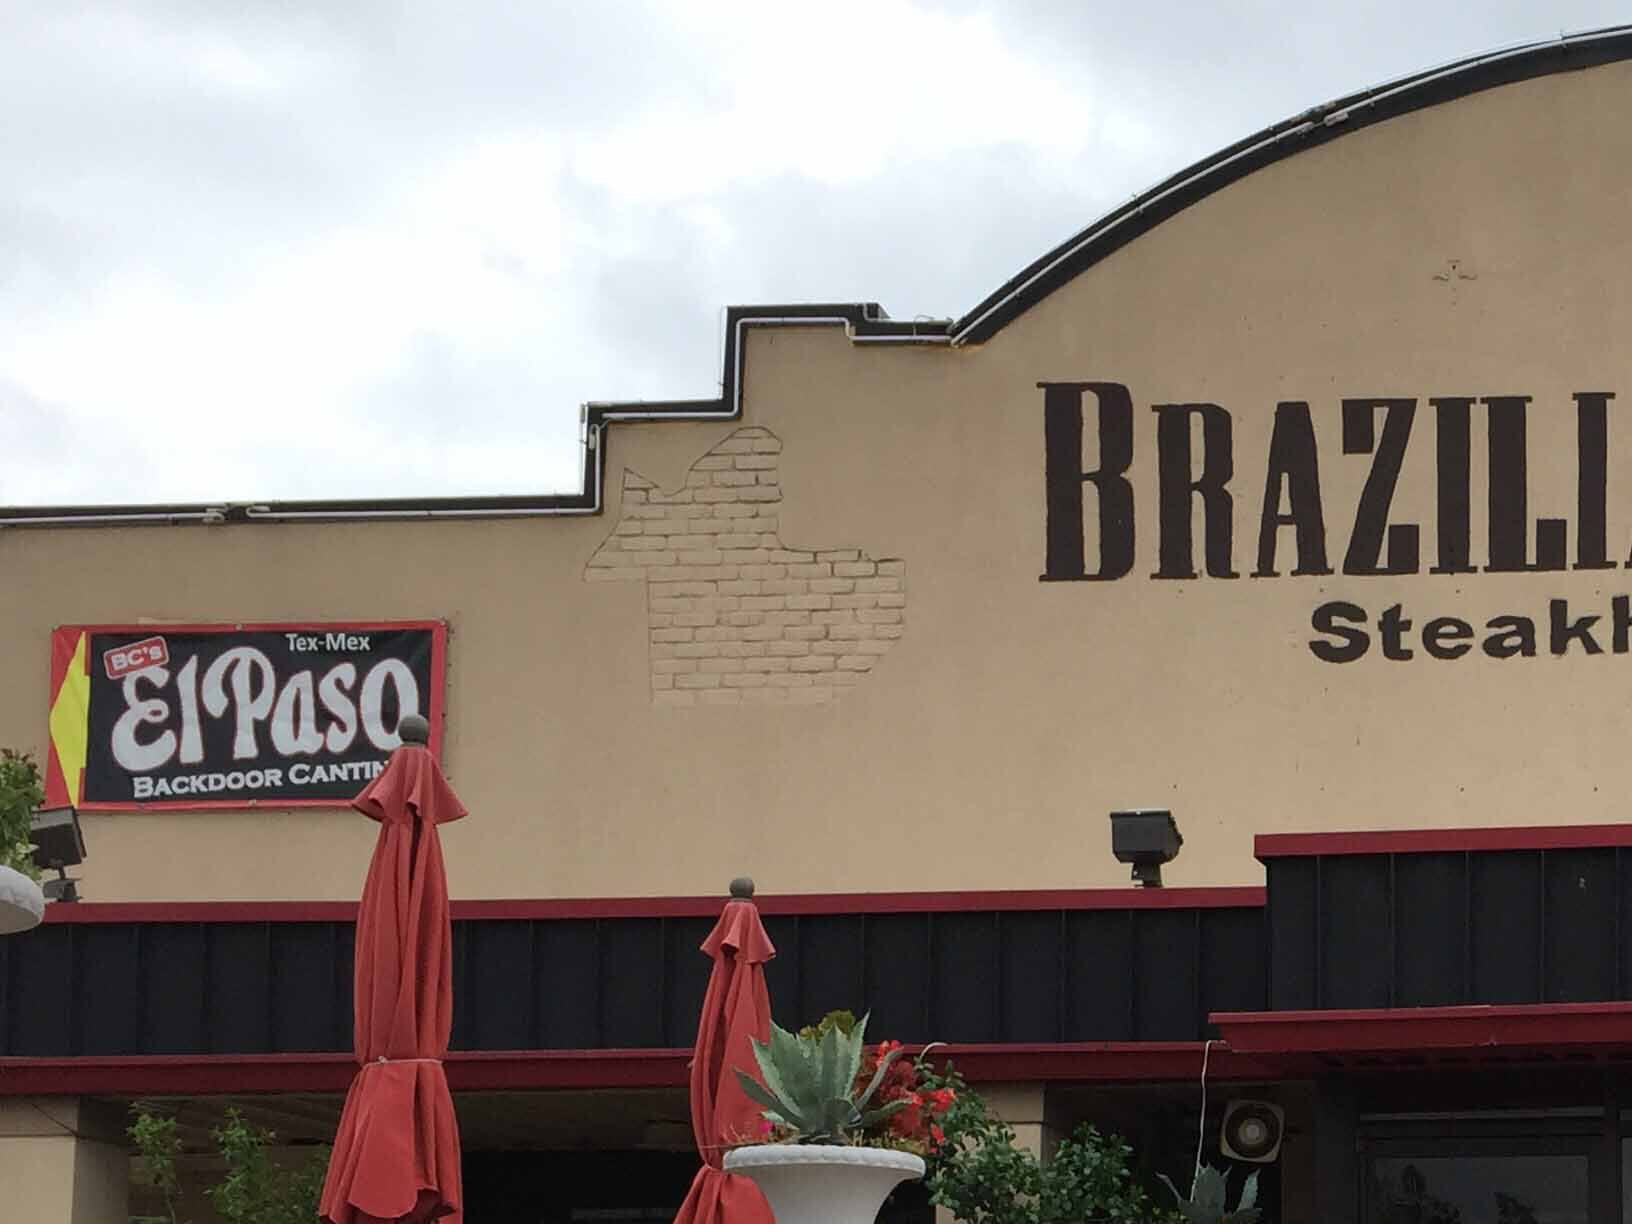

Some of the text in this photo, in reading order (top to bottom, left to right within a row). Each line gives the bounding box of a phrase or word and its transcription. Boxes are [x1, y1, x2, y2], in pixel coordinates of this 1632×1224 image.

[286, 633, 370, 652] Tex-Mex
[133, 760, 390, 799] BACKDOOR CANTIN
